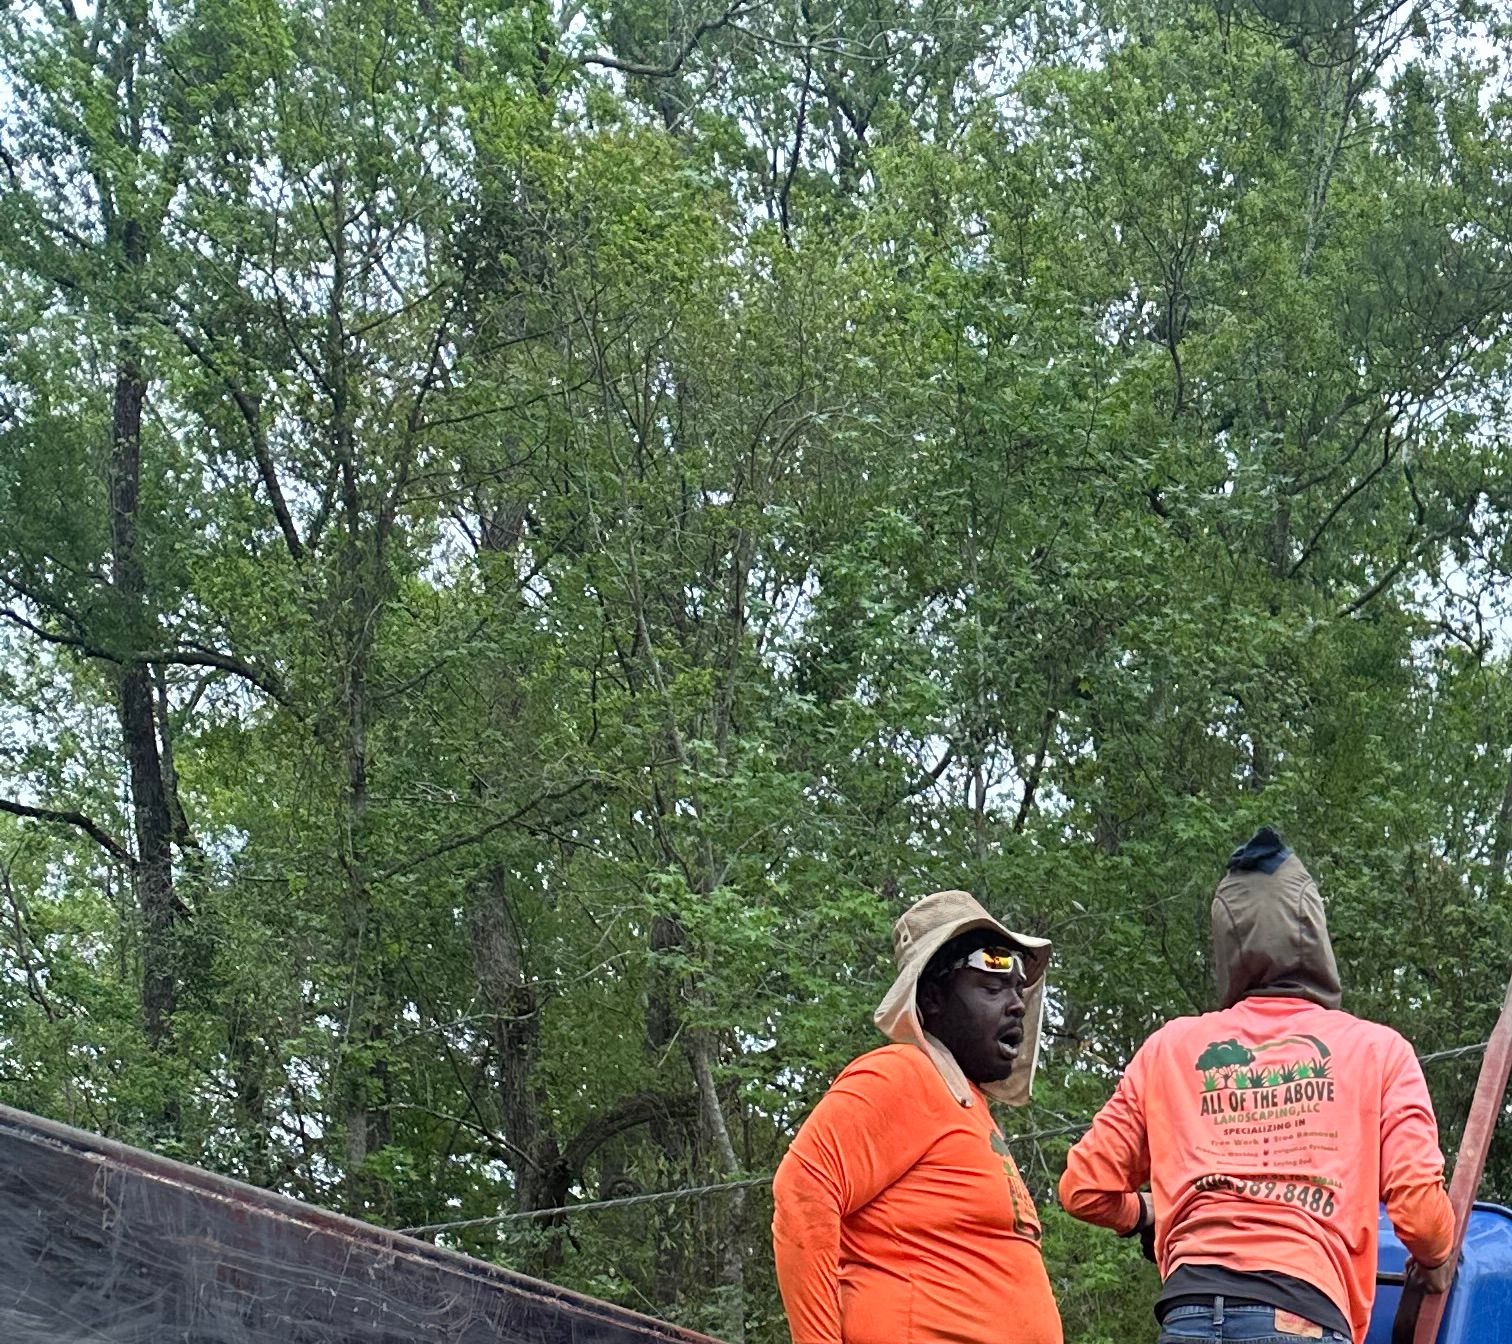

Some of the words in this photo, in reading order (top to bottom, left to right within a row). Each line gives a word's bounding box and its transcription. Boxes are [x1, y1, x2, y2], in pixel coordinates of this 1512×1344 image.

[1200, 1092, 1225, 1116] ALL
[1229, 1091, 1247, 1113] OF
[1252, 1088, 1278, 1109] THE
[1283, 1080, 1335, 1107] ABOVE
[1223, 1122, 1292, 1136] SPECIALIZING
[1294, 1118, 1306, 1128] IN
